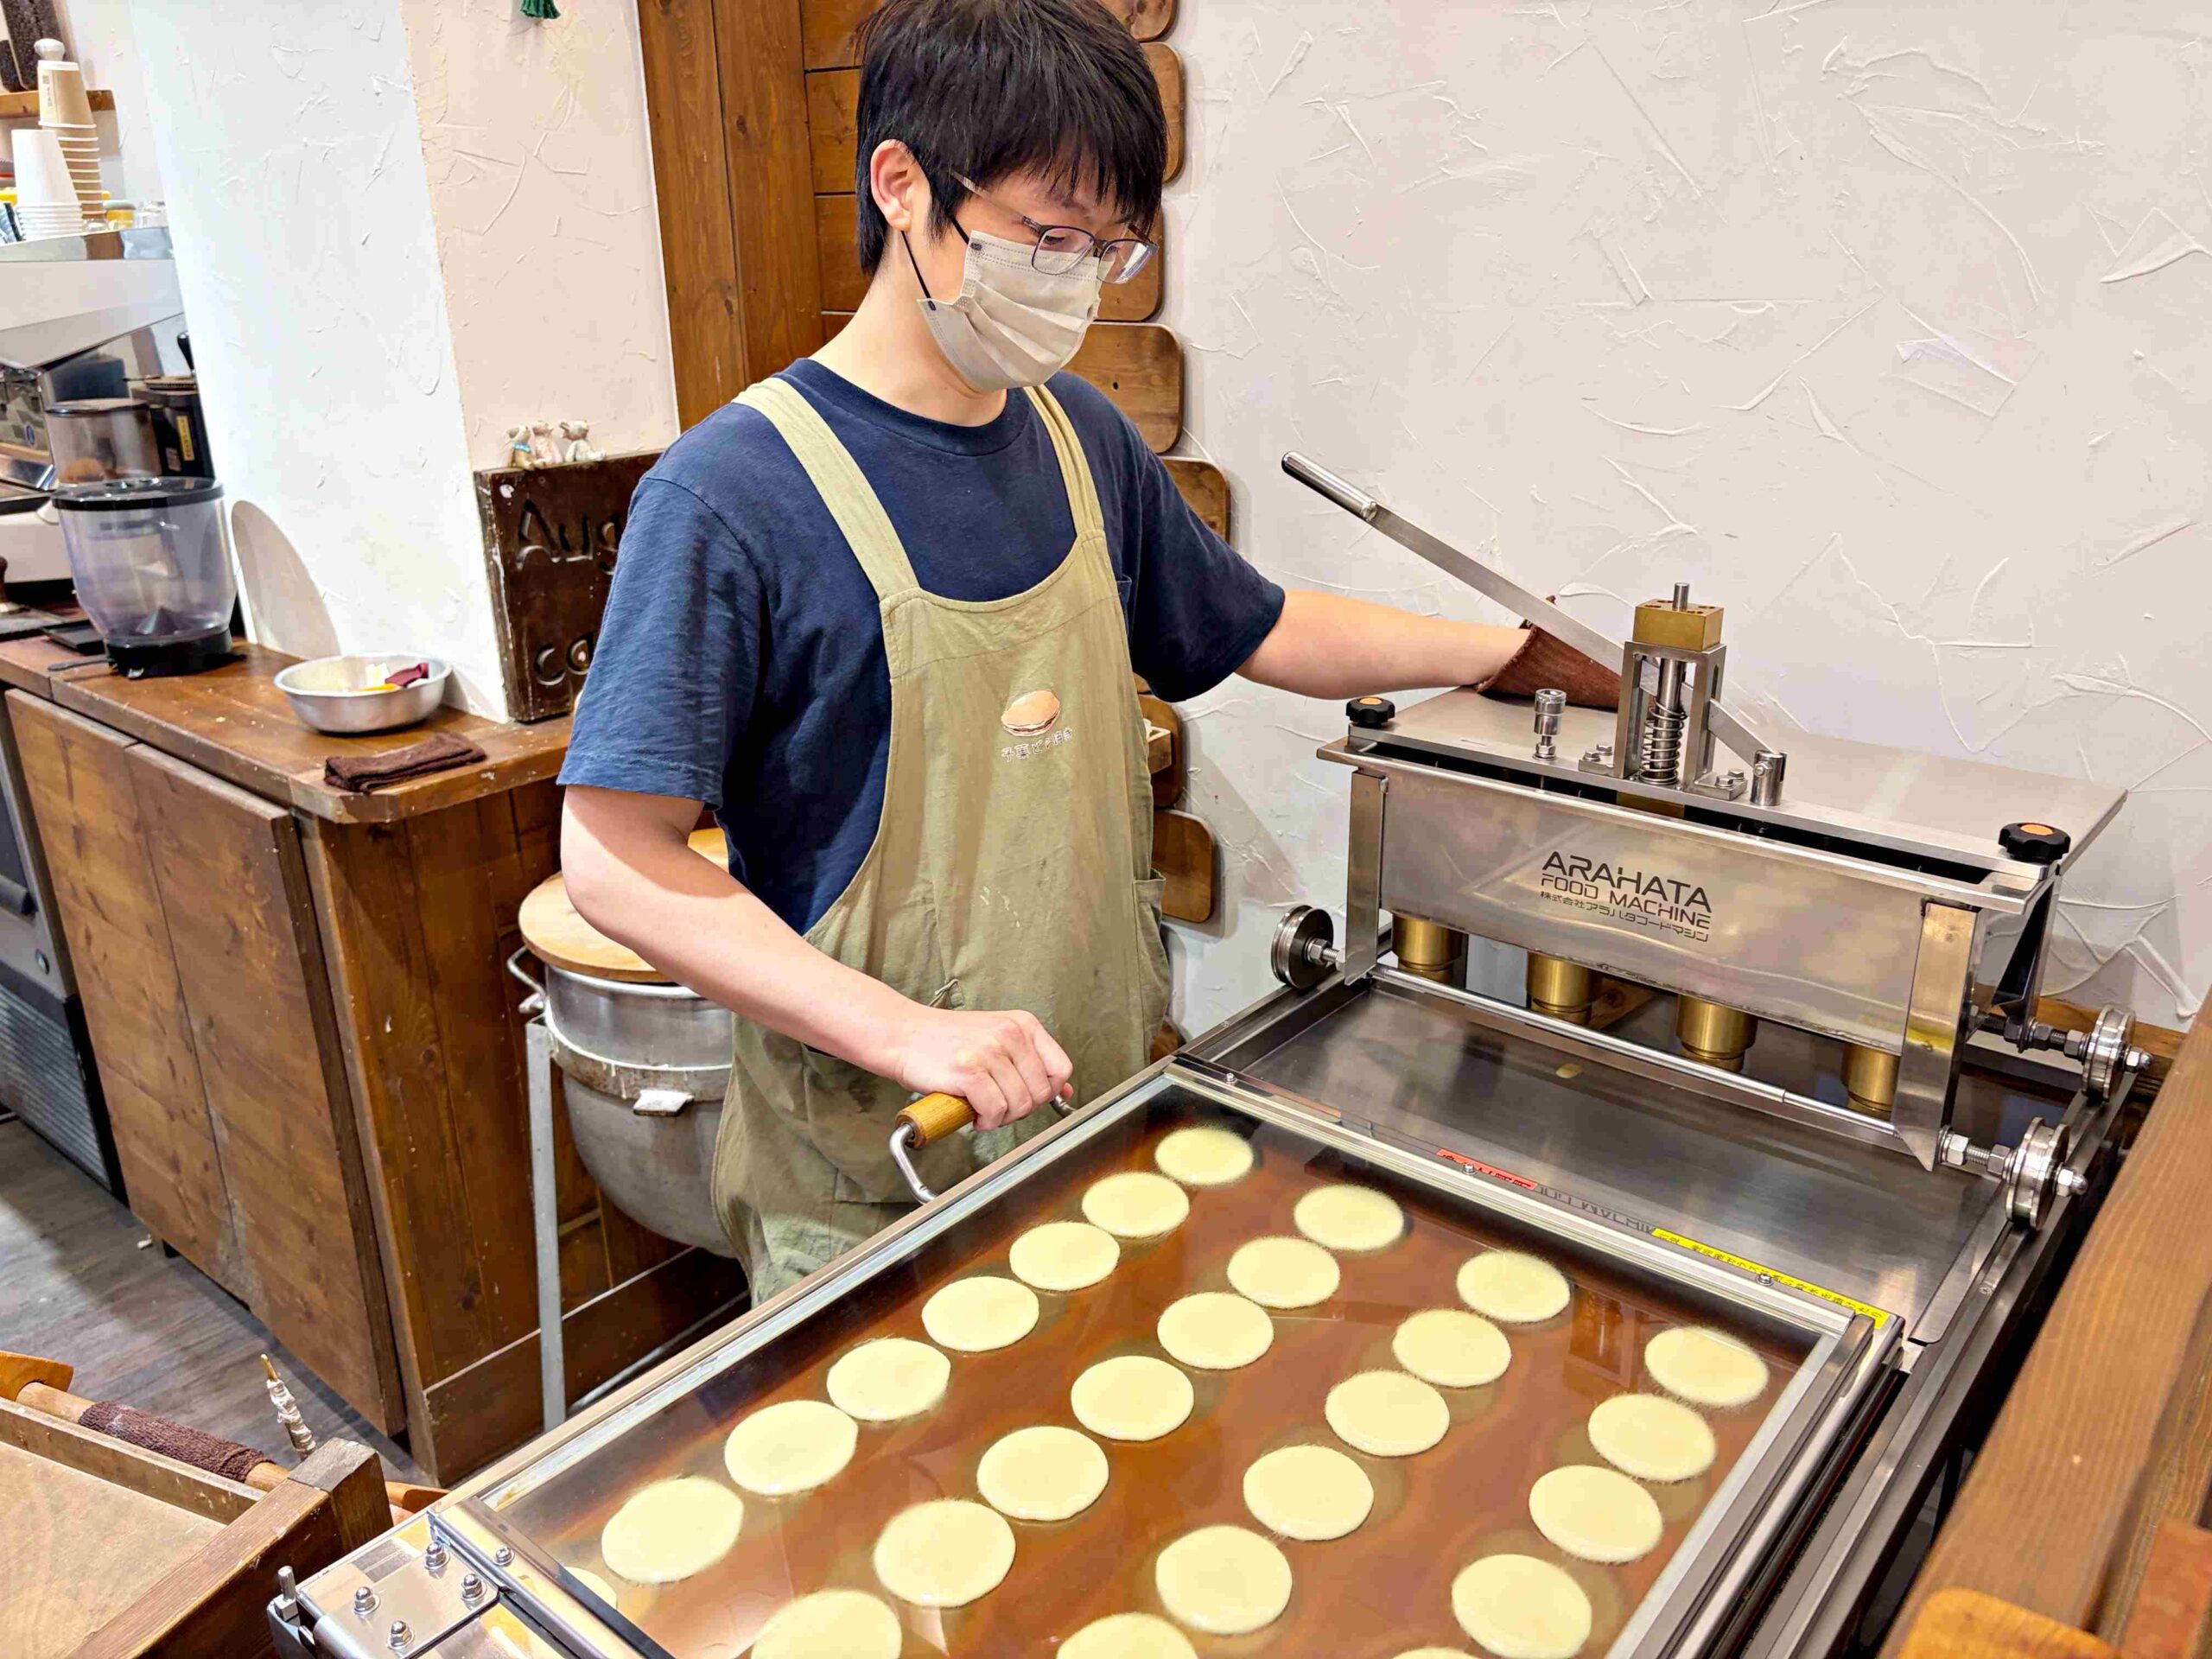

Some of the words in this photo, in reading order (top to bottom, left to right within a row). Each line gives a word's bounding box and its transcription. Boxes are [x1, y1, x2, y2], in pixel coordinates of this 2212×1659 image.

[1541, 850, 1712, 913] ARAHATA
[1541, 873, 1599, 899] FOOD
[1609, 890, 1712, 930] MACHINE
[1540, 891, 1709, 943] 株式会社アラハタフードマシン
